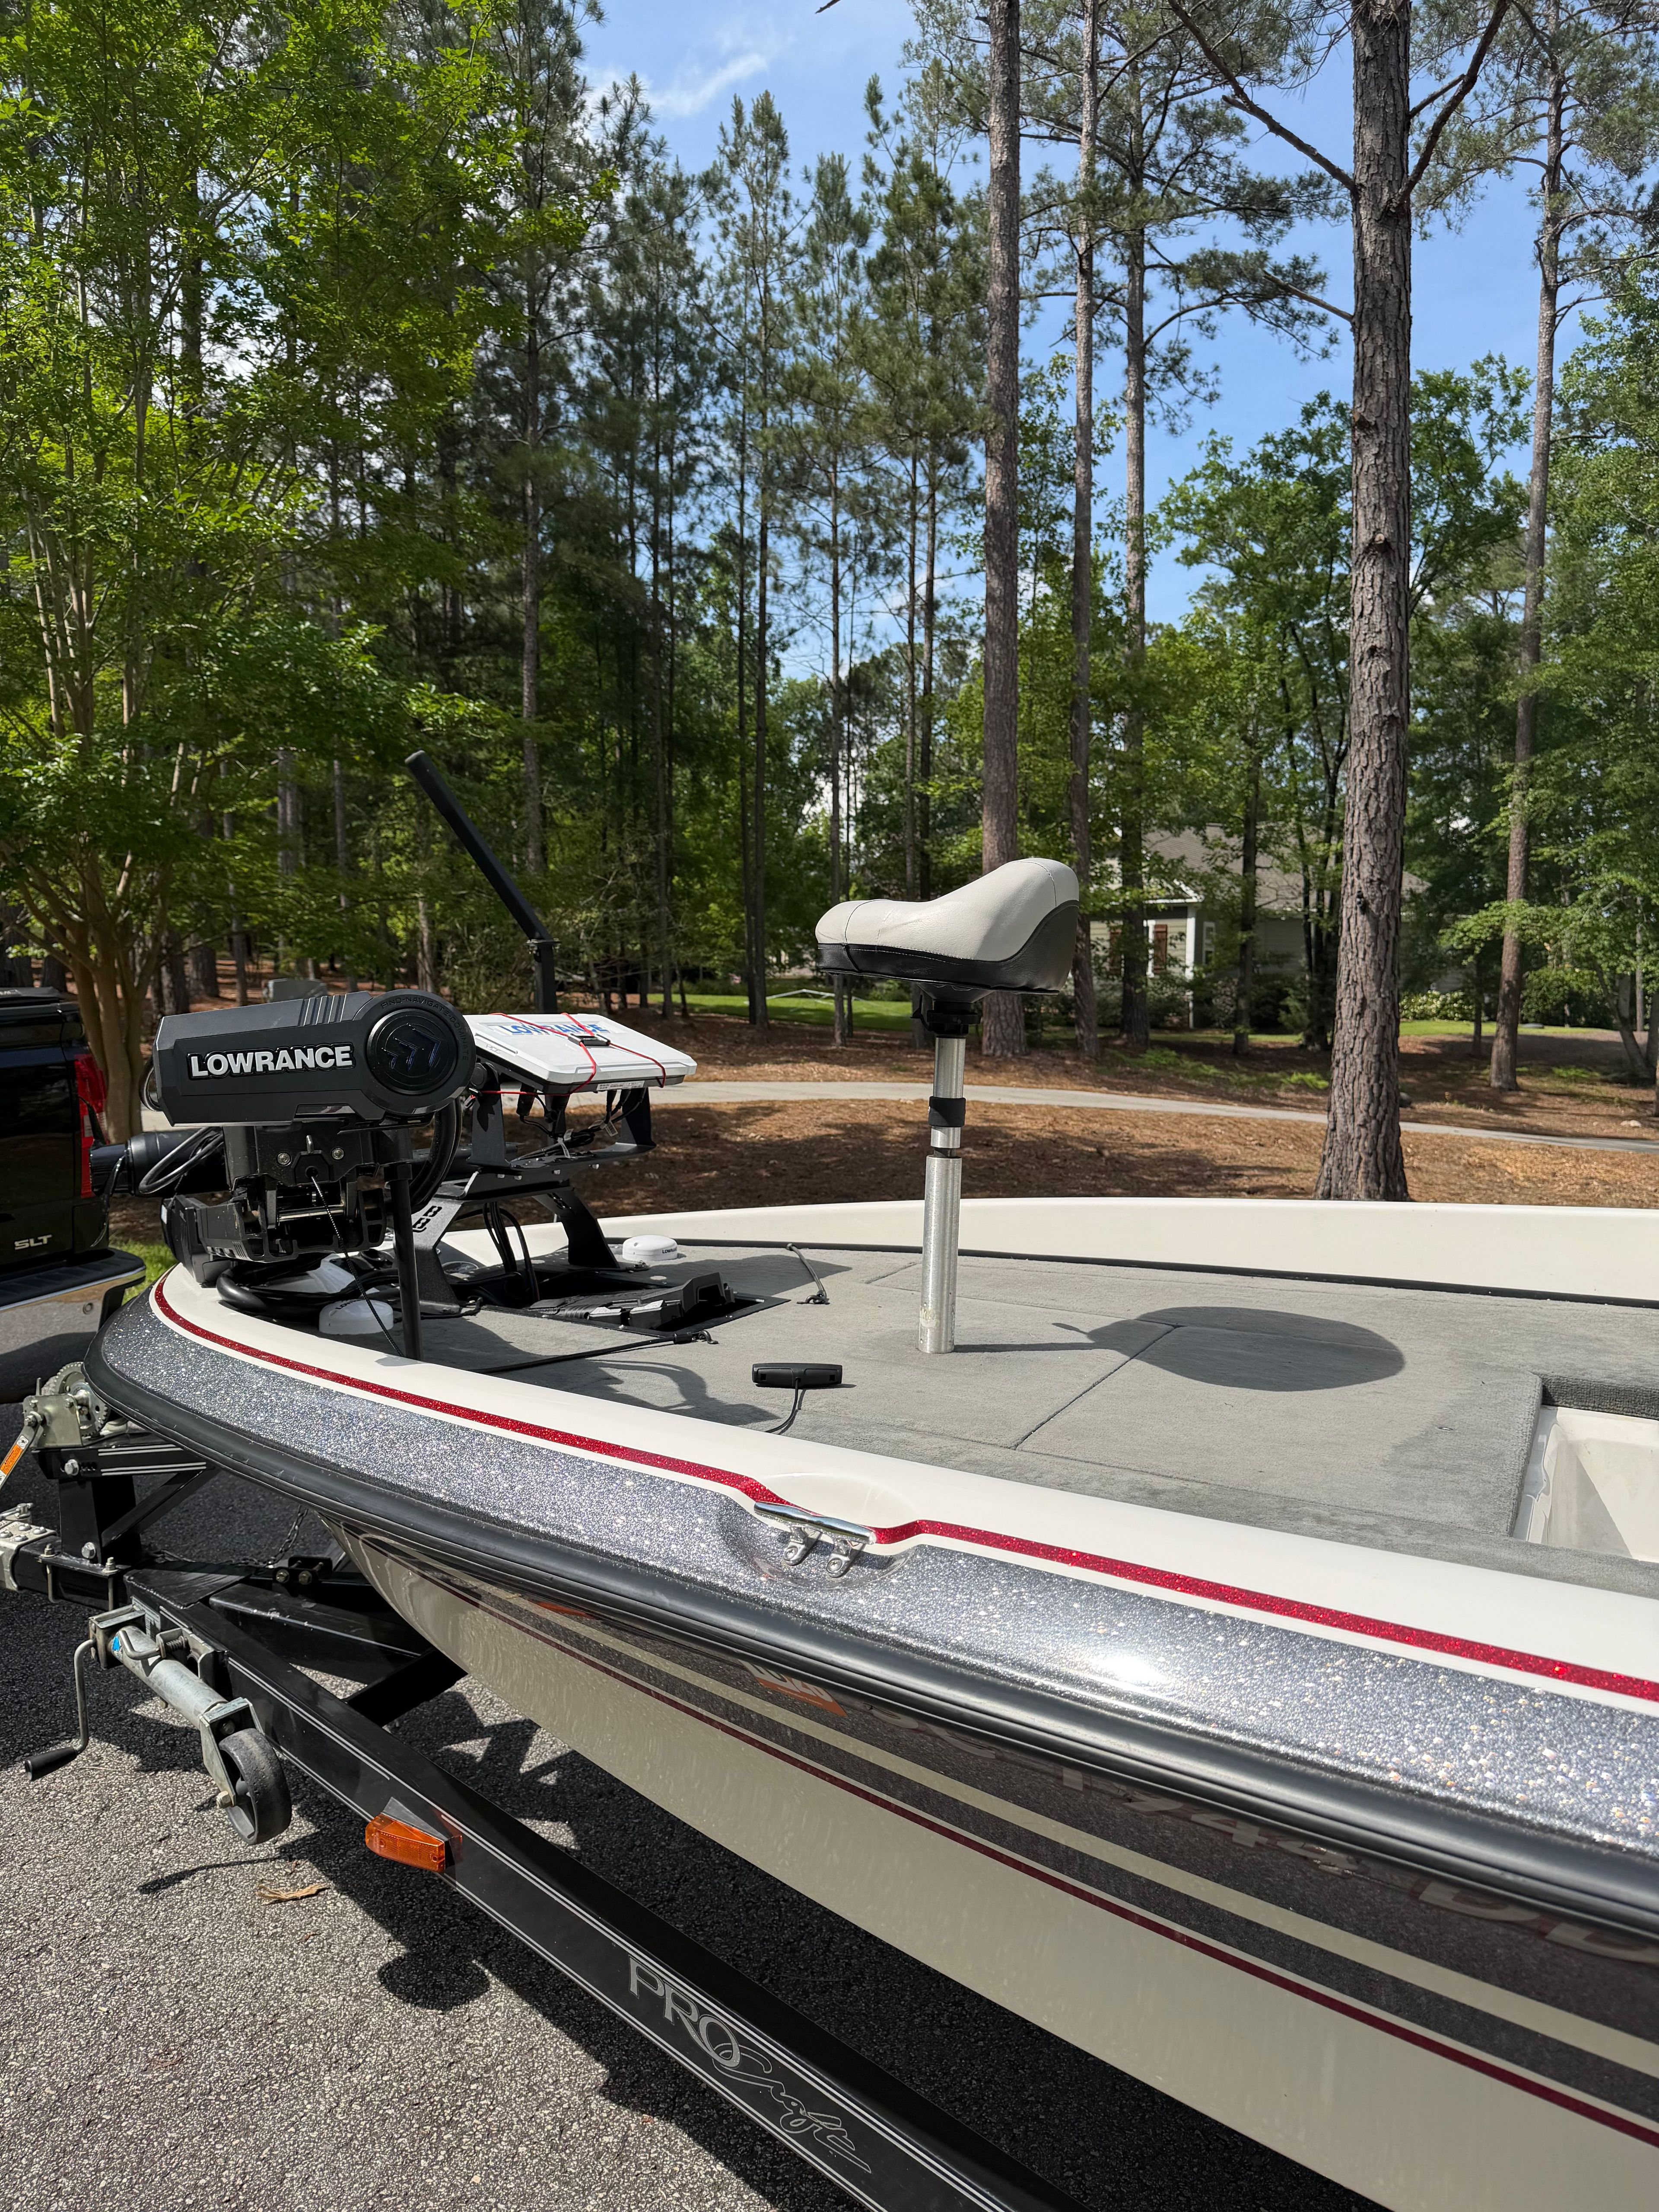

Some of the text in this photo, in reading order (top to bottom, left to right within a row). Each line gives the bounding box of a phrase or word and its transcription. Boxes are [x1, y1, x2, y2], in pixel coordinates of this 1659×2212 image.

[190, 1046, 353, 1077] LOWRANCE
[14, 1234, 52, 1250] SLT
[627, 1955, 741, 2068] PRO
